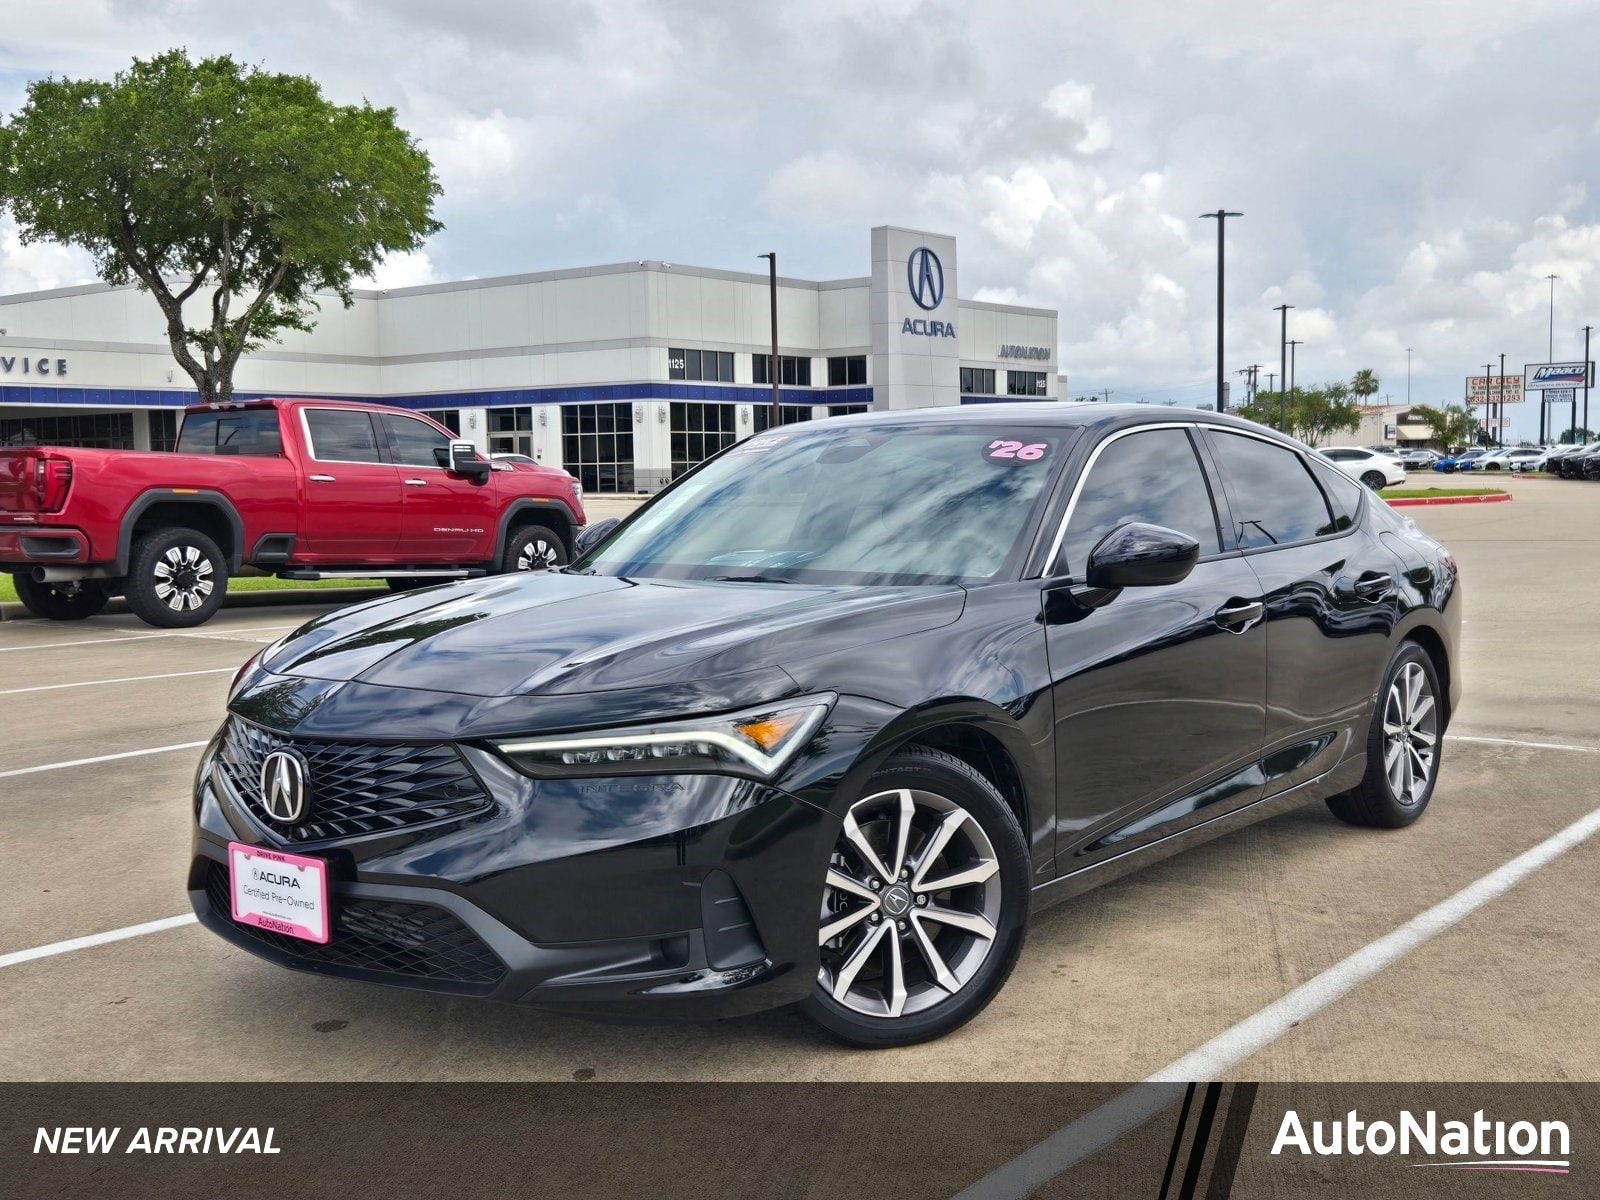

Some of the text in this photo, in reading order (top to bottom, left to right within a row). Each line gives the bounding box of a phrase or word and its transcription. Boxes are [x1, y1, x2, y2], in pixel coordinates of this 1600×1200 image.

[902, 318, 956, 338] ACURA
[0, 356, 67, 376] VICE
[668, 359, 685, 369] 1125
[1533, 366, 1585, 380] Maaco
[577, 783, 686, 793] INTEGRA
[256, 850, 286, 862] DRIVE PINK
[259, 871, 301, 889] ACURA
[243, 884, 315, 910] Certified Pre-Owned
[258, 917, 294, 934] AutoNation
